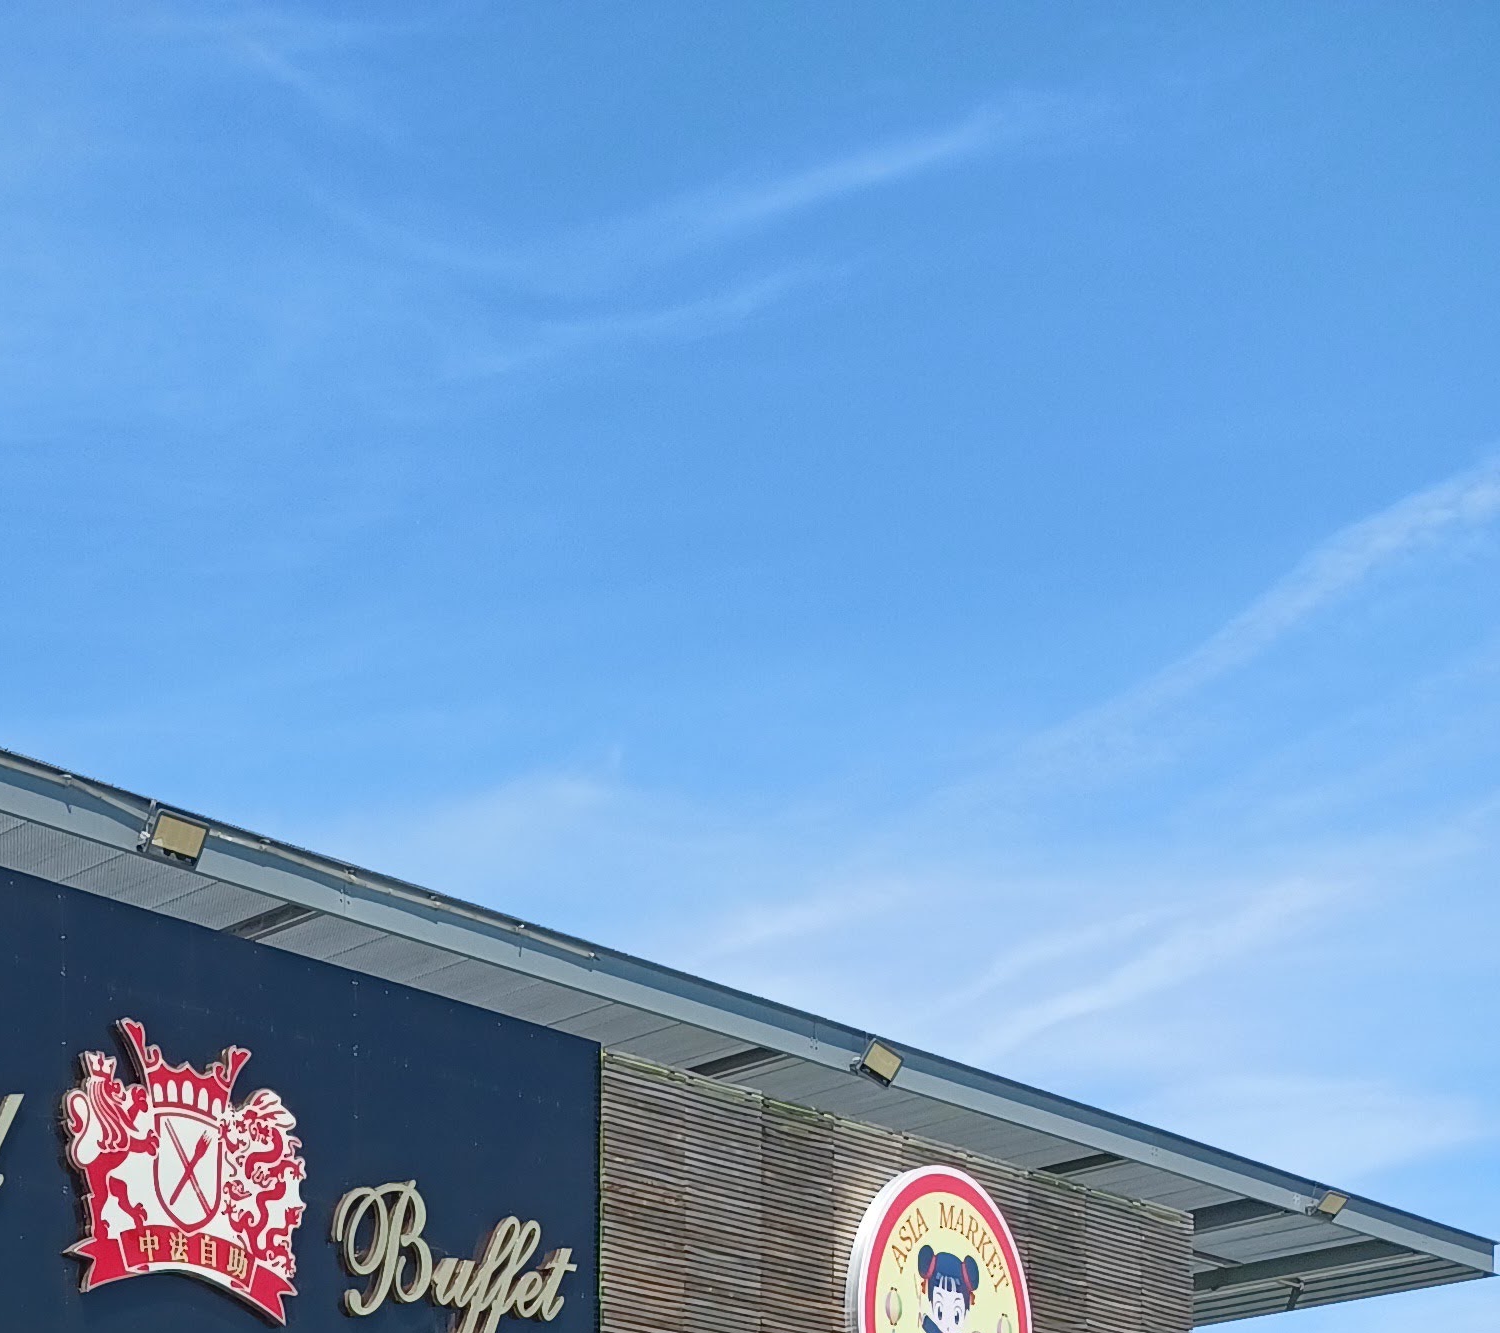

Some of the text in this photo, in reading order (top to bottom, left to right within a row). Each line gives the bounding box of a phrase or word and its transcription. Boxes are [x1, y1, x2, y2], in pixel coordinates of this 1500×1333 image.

[138, 1229, 248, 1280] 中法自助
[891, 1202, 1009, 1292] ASIA MARKET
